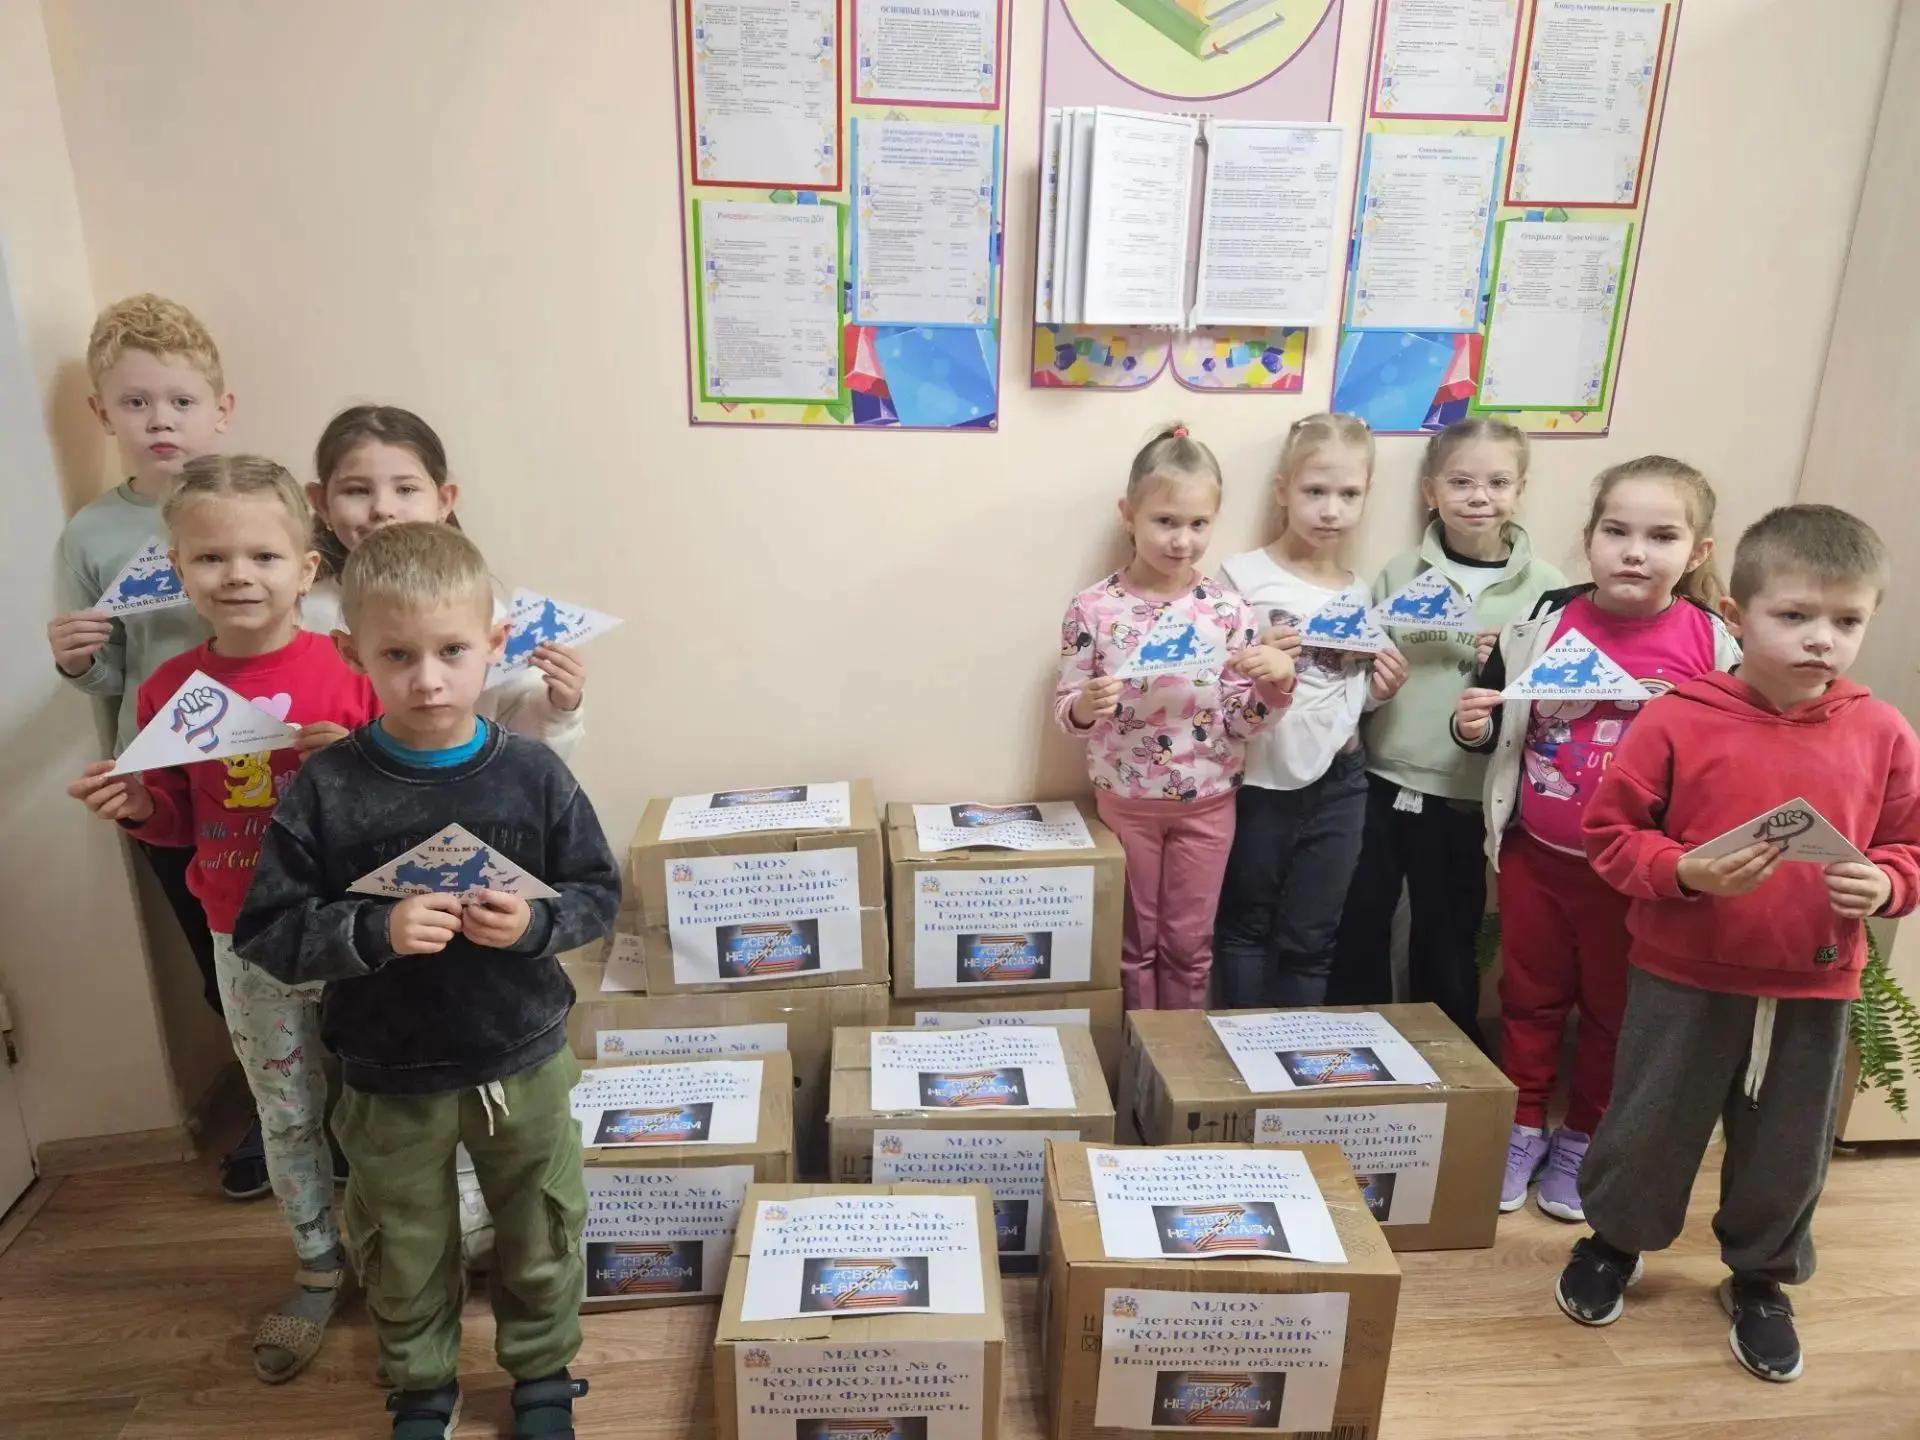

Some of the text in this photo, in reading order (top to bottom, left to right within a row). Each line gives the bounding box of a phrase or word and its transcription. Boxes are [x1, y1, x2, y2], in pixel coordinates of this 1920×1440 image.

[139, 555, 165, 563] ПИСЬ
[156, 576, 173, 591] Z
[112, 595, 180, 611] РОССИЙСКОМУ
[1418, 602, 1432, 614] Z
[1333, 622, 1347, 634] Z
[1166, 644, 1179, 657] Z
[1564, 669, 1578, 683] Z
[732, 858, 791, 871] МДОУ
[440, 872, 459, 886] Z
[693, 872, 762, 886] детский
[766, 872, 793, 882] сад
[821, 868, 831, 877] 6
[978, 874, 1031, 885] МДОУ
[1059, 884, 1068, 892] 6
[693, 893, 835, 913] Город Фурманов
[989, 906, 1070, 921] Фурманов
[725, 949, 744, 962] НЕ
[964, 957, 981, 968] НЕ
[1324, 1112, 1378, 1122] МДОУ
[1408, 1123, 1417, 1131] 6
[946, 1137, 1006, 1146] МДОУ
[1164, 1153, 1228, 1162] МДОУ
[884, 1162, 1040, 1172] "КОЛОКОЛЬЧИ
[1367, 1161, 1430, 1170] область
[612, 1174, 680, 1184] МДОУ
[589, 1188, 643, 1197] тский
[712, 1188, 721, 1196] 6
[995, 1188, 1043, 1196] облас
[589, 1200, 740, 1211] ЛОКОЛЬЧИК"
[835, 1201, 898, 1210] МДОУ
[588, 1213, 724, 1227] род Фурманов
[934, 1212, 944, 1220] 6
[585, 1229, 661, 1237] новская
[846, 1234, 950, 1244] Фурманов
[1167, 1228, 1190, 1239] НЕ
[596, 1269, 616, 1280] НЕ
[811, 1280, 919, 1295] НЕ БРОСАЕМ
[1190, 1300, 1265, 1312] МДОУ
[1137, 1316, 1312, 1327] детский сад № 6
[1116, 1328, 1332, 1341] "КОЛОКОЛЬЧИК"
[822, 1349, 897, 1360] МДОУ
[1133, 1344, 1312, 1356] Город Фурманов
[770, 1364, 857, 1374] детский
[864, 1364, 898, 1373] сад
[936, 1361, 947, 1370] 6
[1113, 1356, 1329, 1368] Ивановская область
[749, 1374, 970, 1388] "КОЛОКОЛЬЧИК"
[769, 1391, 951, 1403] Город Фурманов
[1184, 1386, 1249, 1398] #СВОИХ
[750, 1402, 970, 1415] Ивановская область
[1163, 1398, 1272, 1411] НЕ БРОСАЕМ
